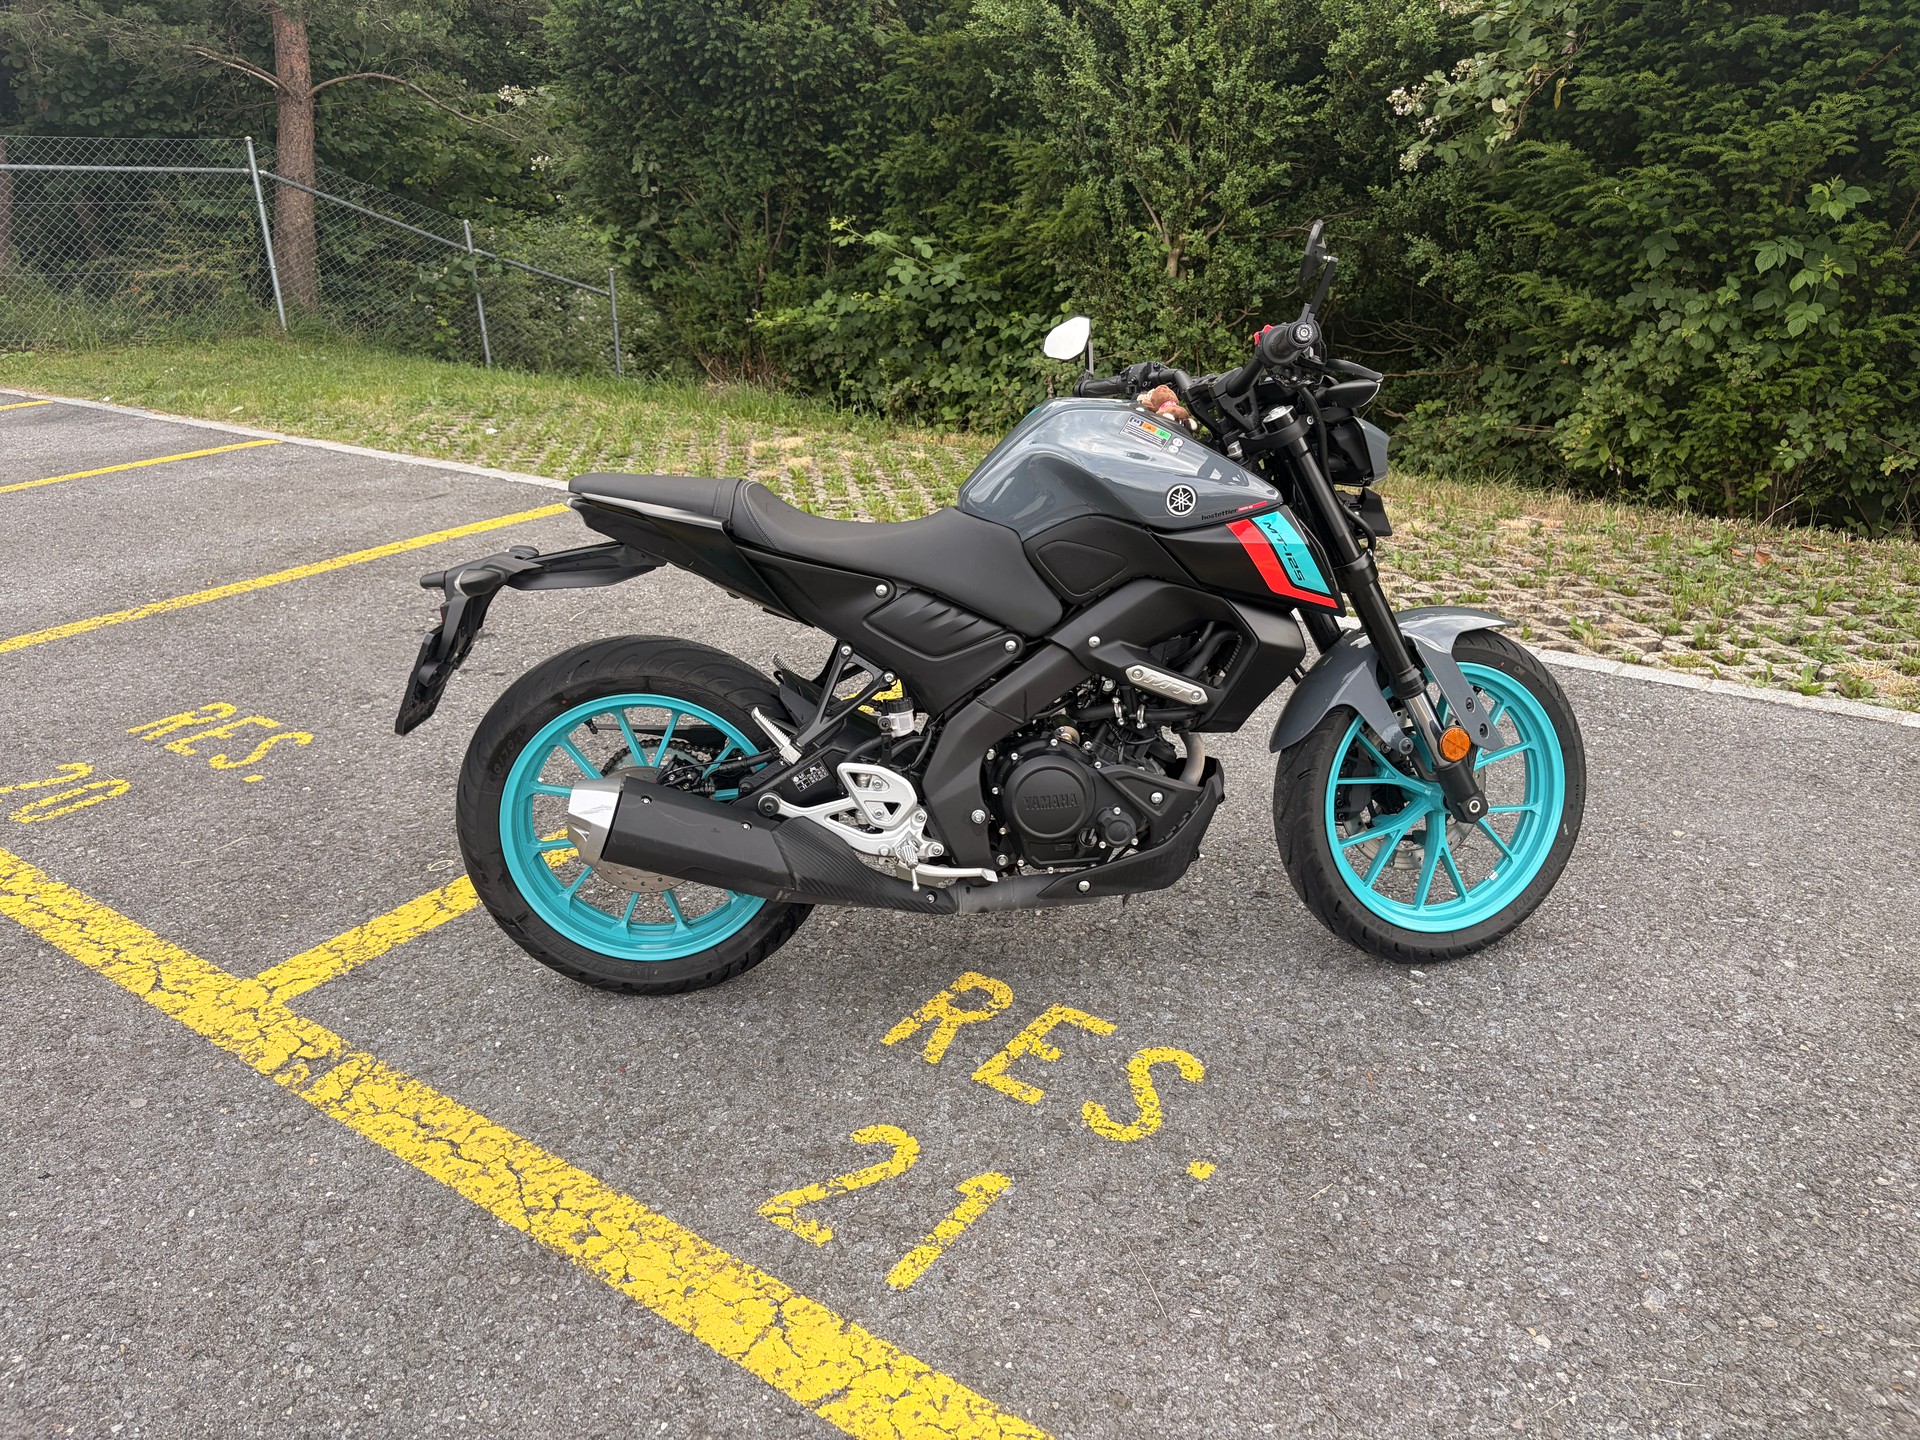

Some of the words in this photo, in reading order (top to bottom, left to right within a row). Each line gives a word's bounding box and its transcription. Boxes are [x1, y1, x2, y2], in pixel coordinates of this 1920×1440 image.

[1263, 521, 1306, 581] MT-125
[128, 702, 313, 784] RES.
[1024, 793, 1078, 811] YAMAHA
[882, 972, 1217, 1181] RES.
[757, 1124, 1012, 1291] 21
